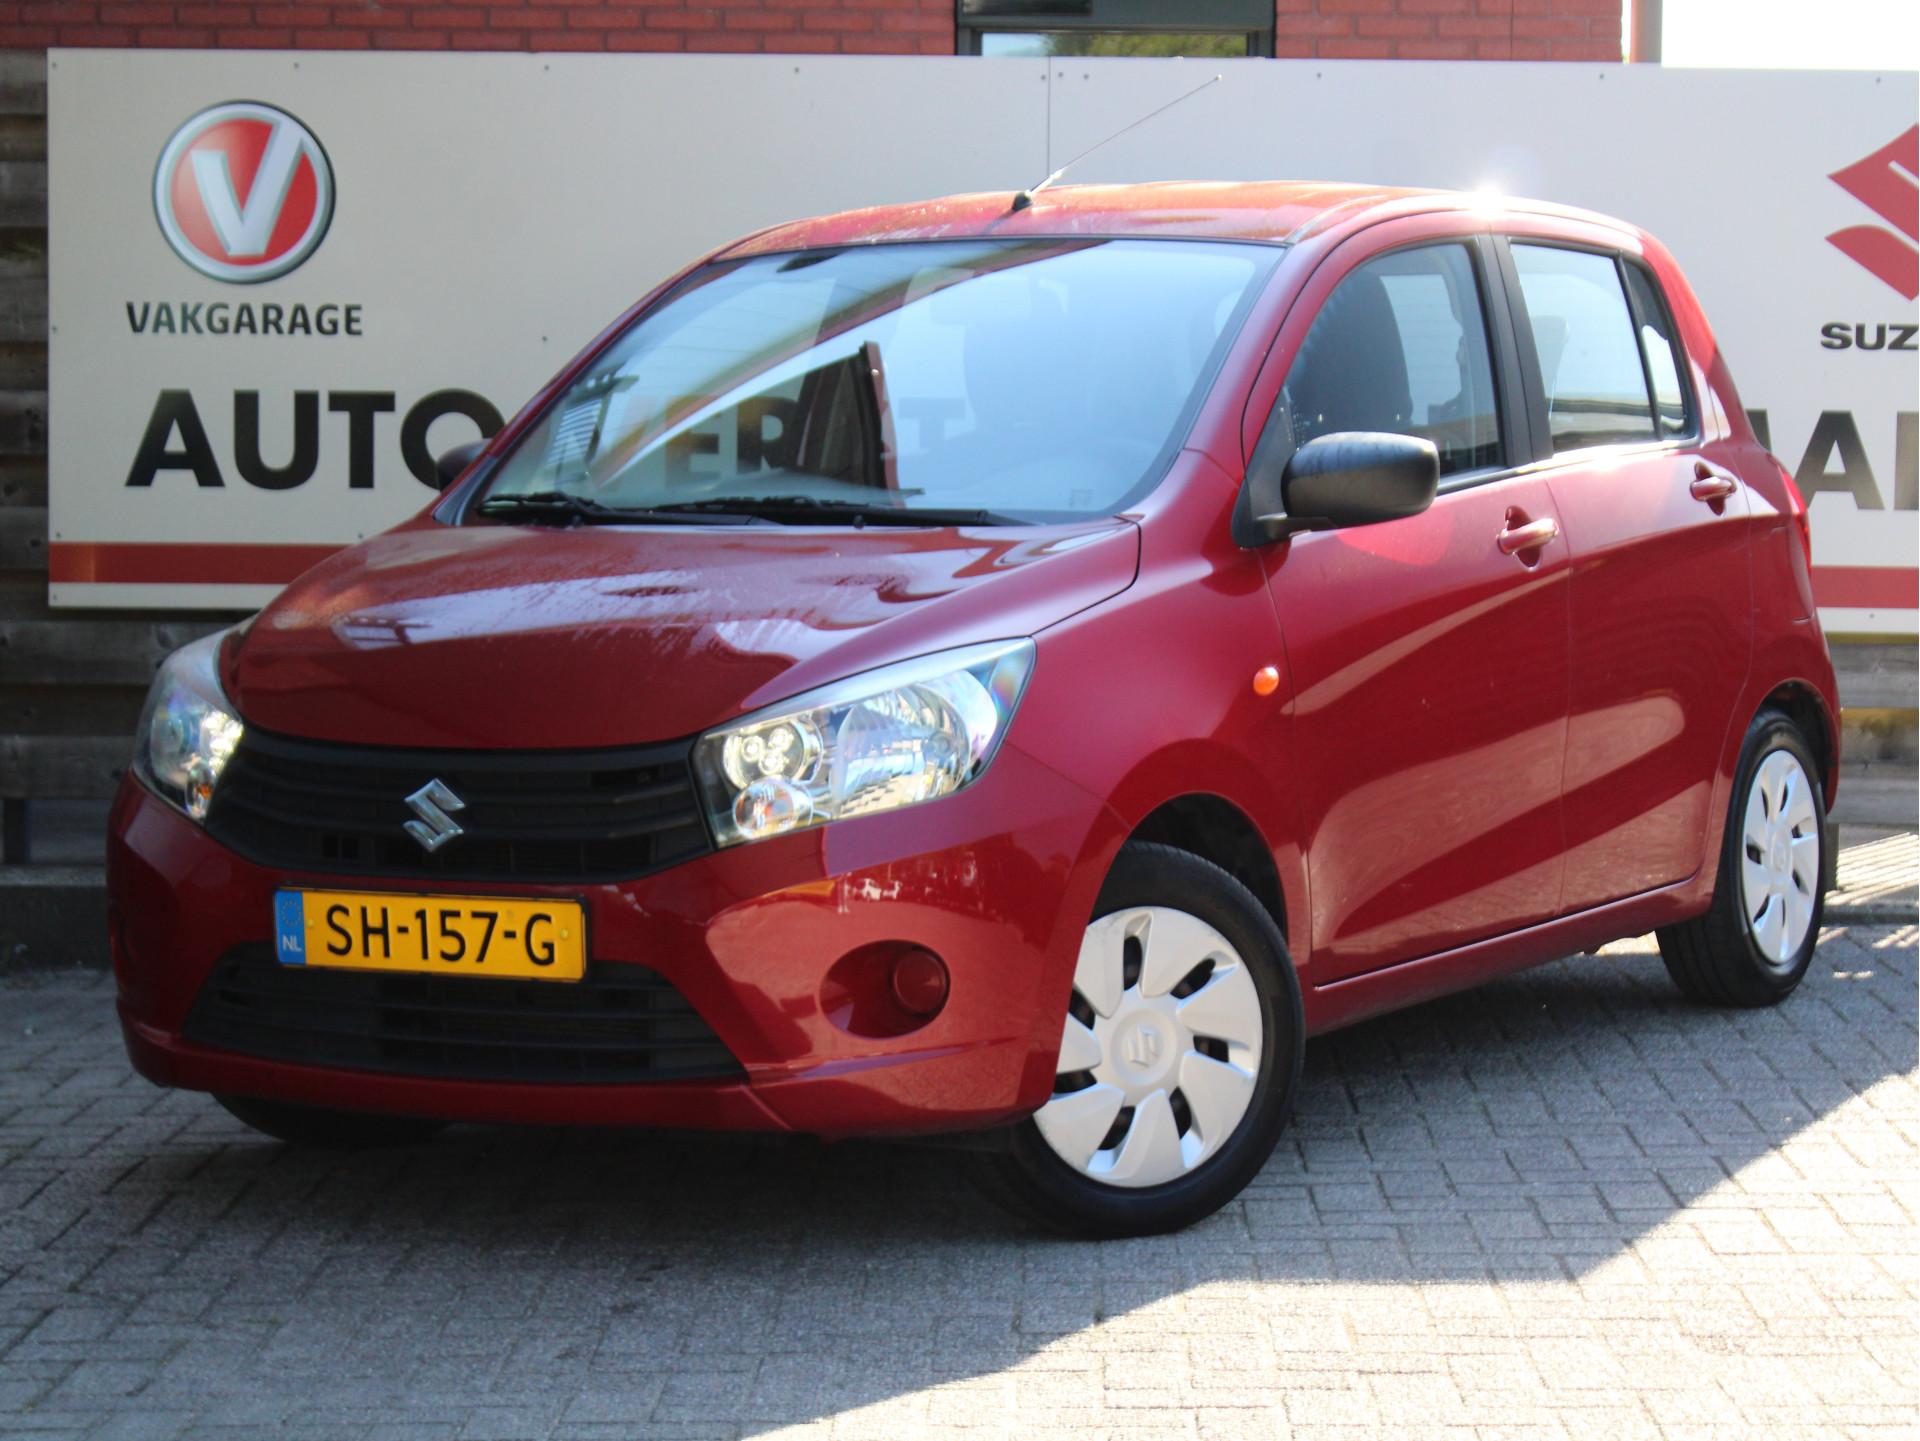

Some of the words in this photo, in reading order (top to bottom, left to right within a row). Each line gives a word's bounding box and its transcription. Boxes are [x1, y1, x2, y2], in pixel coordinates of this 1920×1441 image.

[126, 301, 363, 336] VAKGARAGE
[282, 935, 303, 952] NL
[325, 904, 556, 967] SH-157-G
